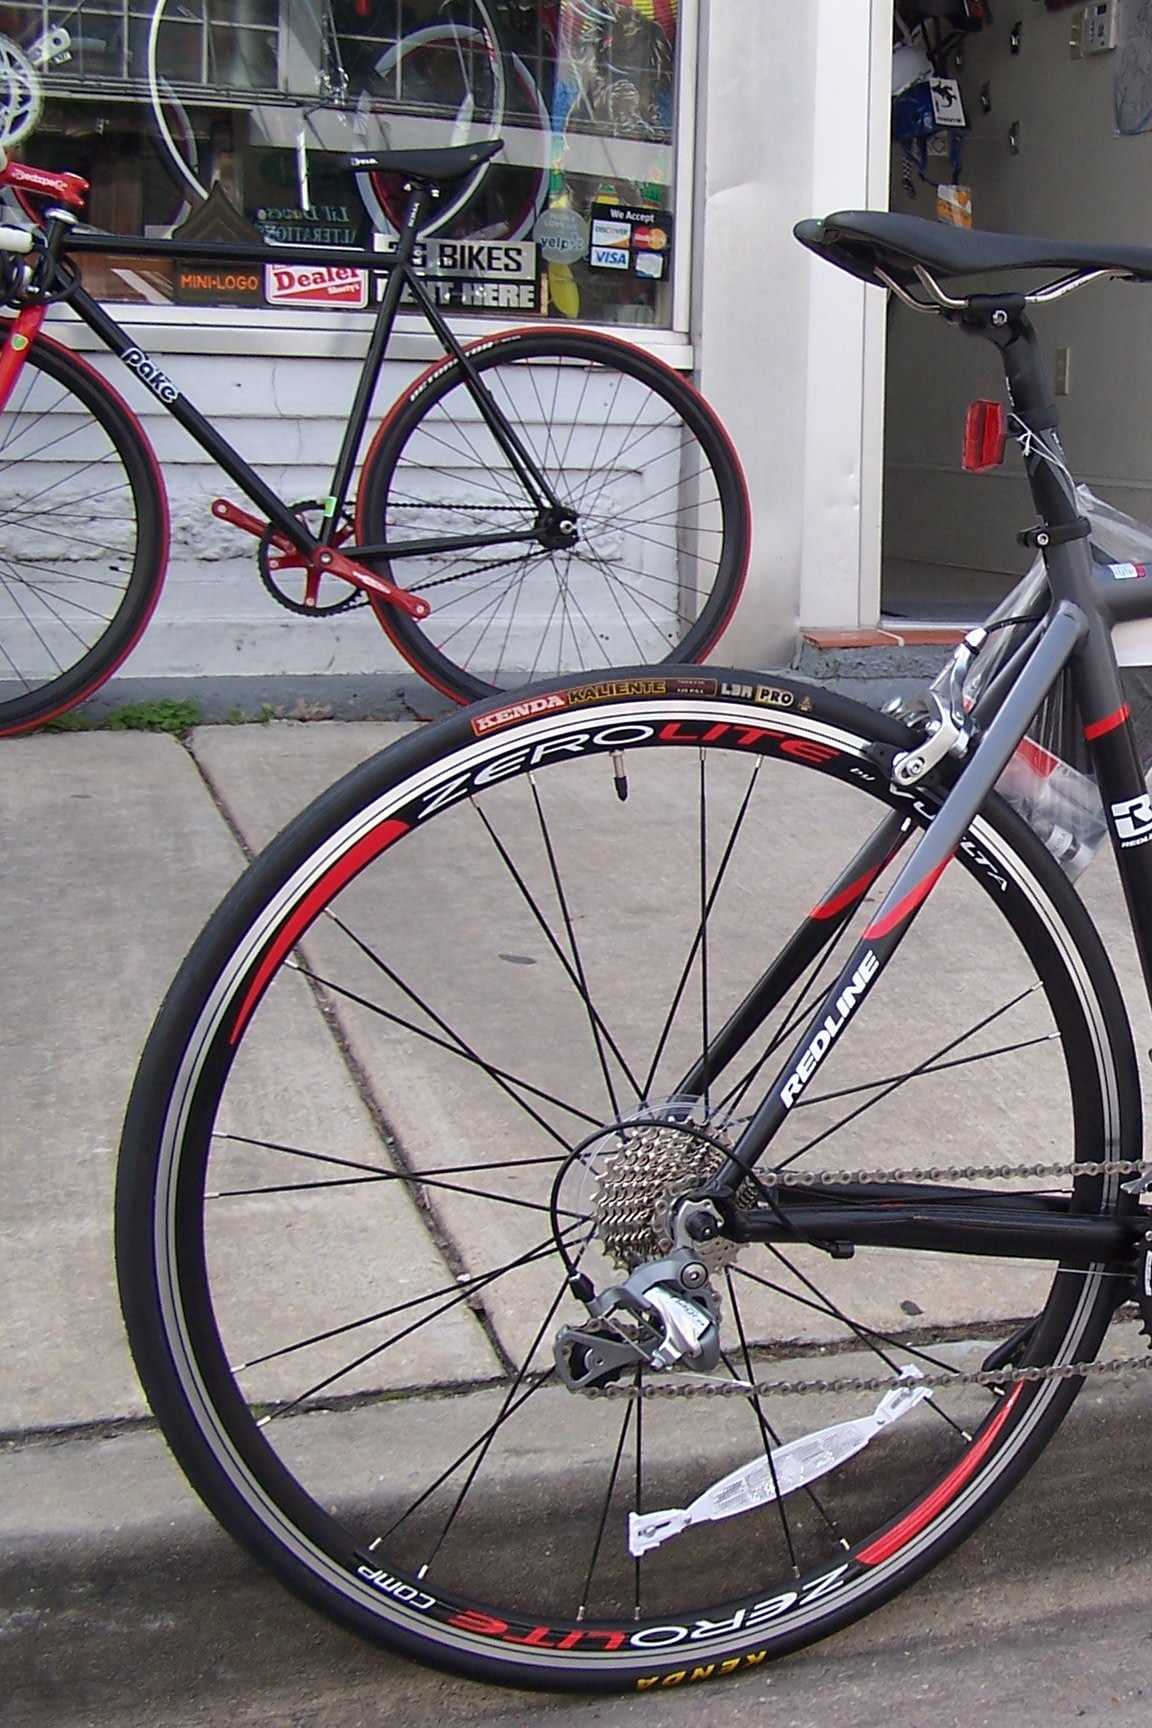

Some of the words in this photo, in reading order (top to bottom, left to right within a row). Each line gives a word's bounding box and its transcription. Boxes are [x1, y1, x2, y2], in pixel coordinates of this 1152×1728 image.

[610, 208, 624, 219] We
[626, 210, 655, 223] Accept
[439, 243, 523, 273] BIKES
[540, 236, 569, 250] yelp
[595, 250, 627, 265] VISA
[273, 265, 360, 292] Dealer
[462, 281, 536, 309] HERE
[120, 347, 179, 403] pake
[476, 694, 566, 731] KENDA
[568, 680, 667, 704] KALIENTE
[759, 686, 794, 706] PRO
[779, 949, 880, 1111] REDLINE
[357, 1564, 437, 1610] COMP
[636, 1650, 768, 1691] KENDA
